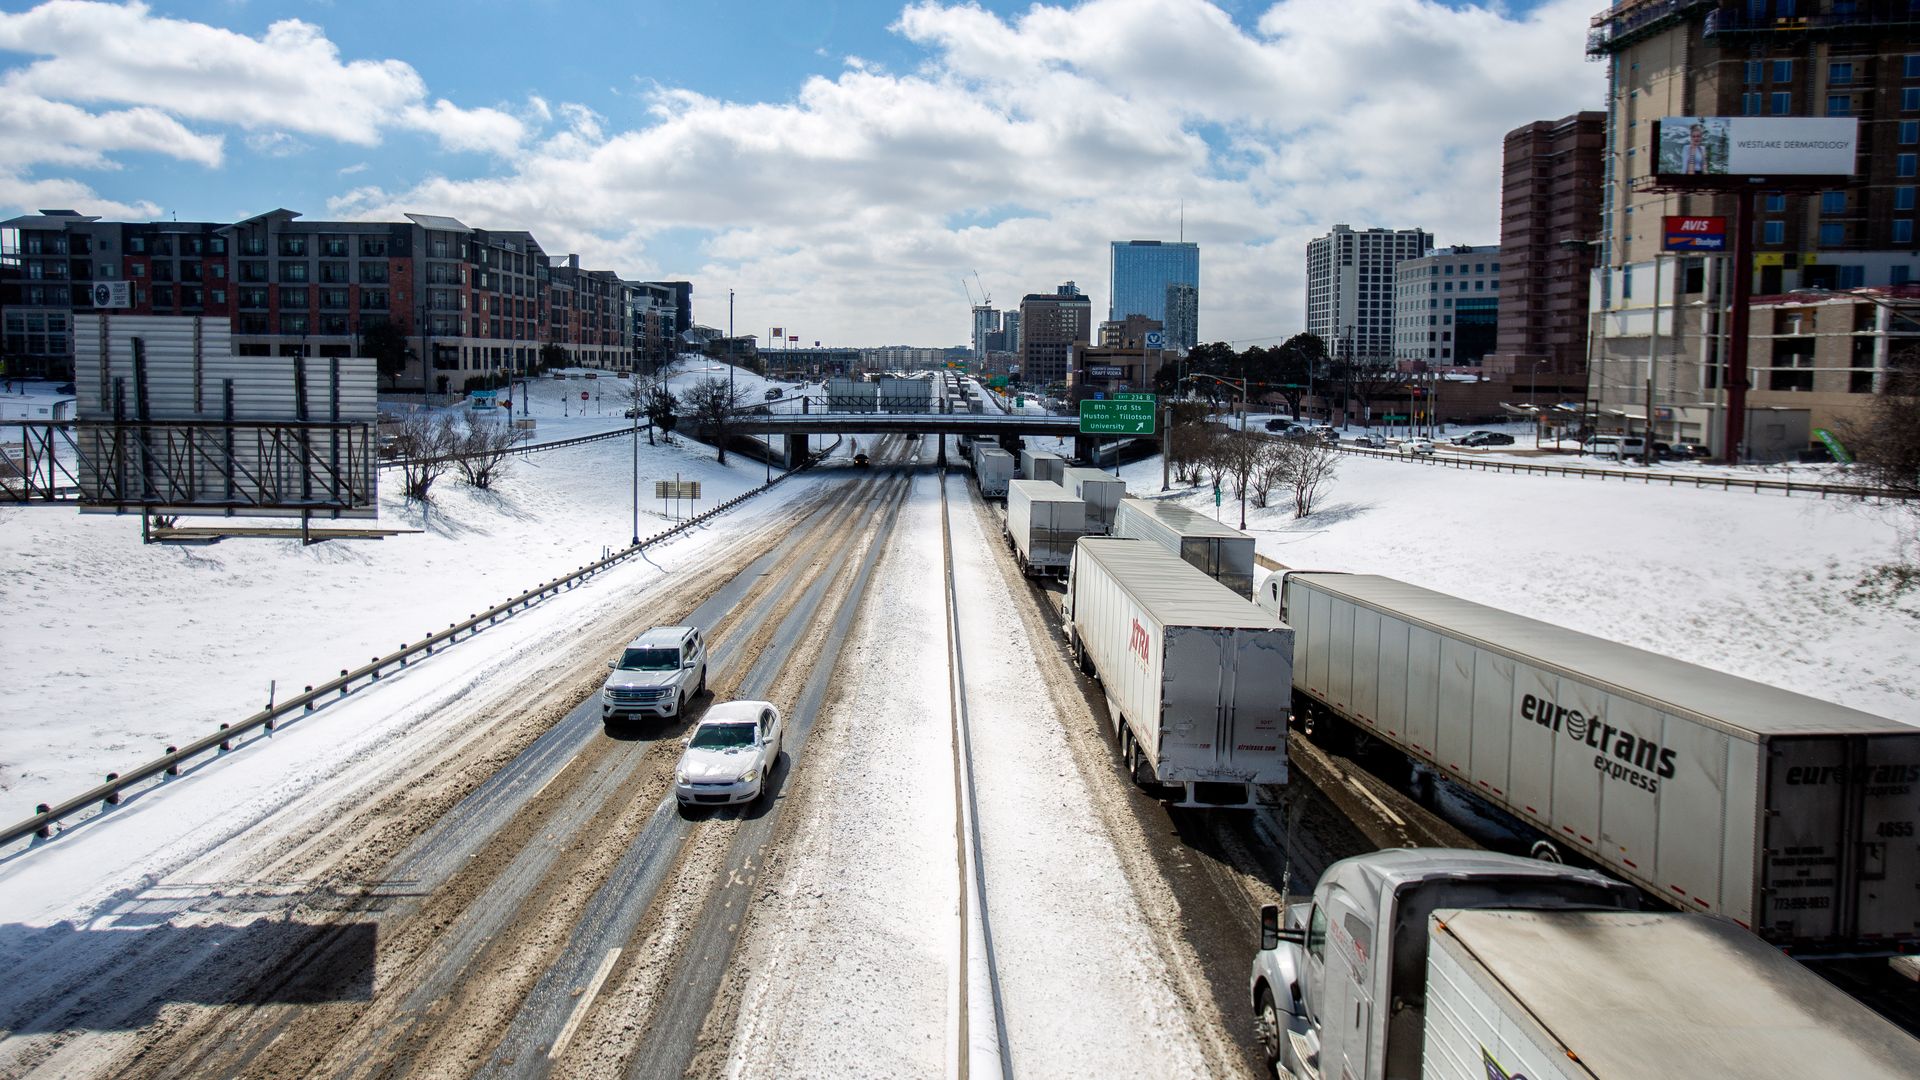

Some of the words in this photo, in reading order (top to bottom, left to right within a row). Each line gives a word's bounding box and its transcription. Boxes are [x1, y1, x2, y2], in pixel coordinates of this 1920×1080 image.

[1737, 140, 1782, 149] WESTLAKE
[1784, 140, 1849, 150] DERMATOLOGY
[1681, 220, 1709, 231] AVIS
[1696, 237, 1721, 248] Budget
[1129, 618, 1150, 665] XTRA
[1594, 755, 1658, 794] express
[1864, 784, 1911, 798] express
[1877, 821, 1913, 837] 4655
